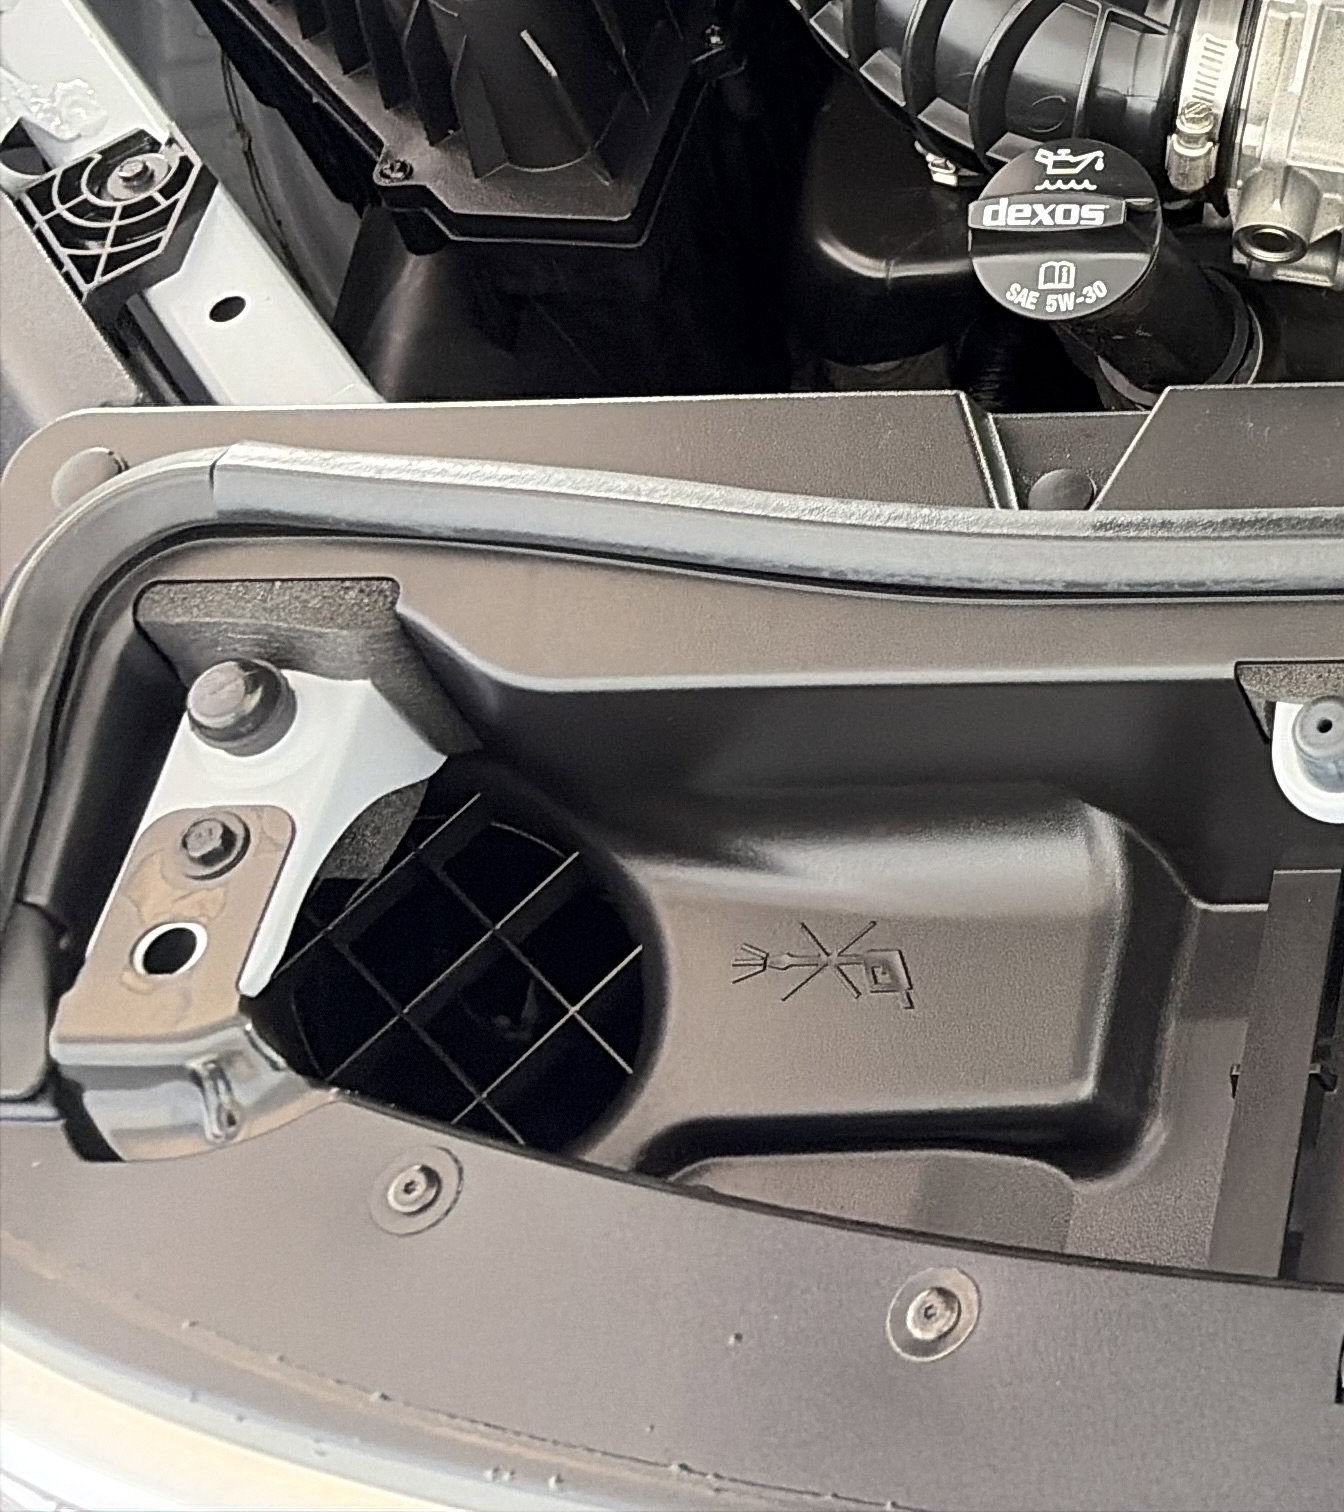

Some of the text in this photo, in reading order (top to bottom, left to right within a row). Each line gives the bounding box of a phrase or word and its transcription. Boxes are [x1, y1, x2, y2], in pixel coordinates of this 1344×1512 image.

[982, 197, 1105, 226] dexos
[1005, 280, 1108, 313] SAE 5W-30
